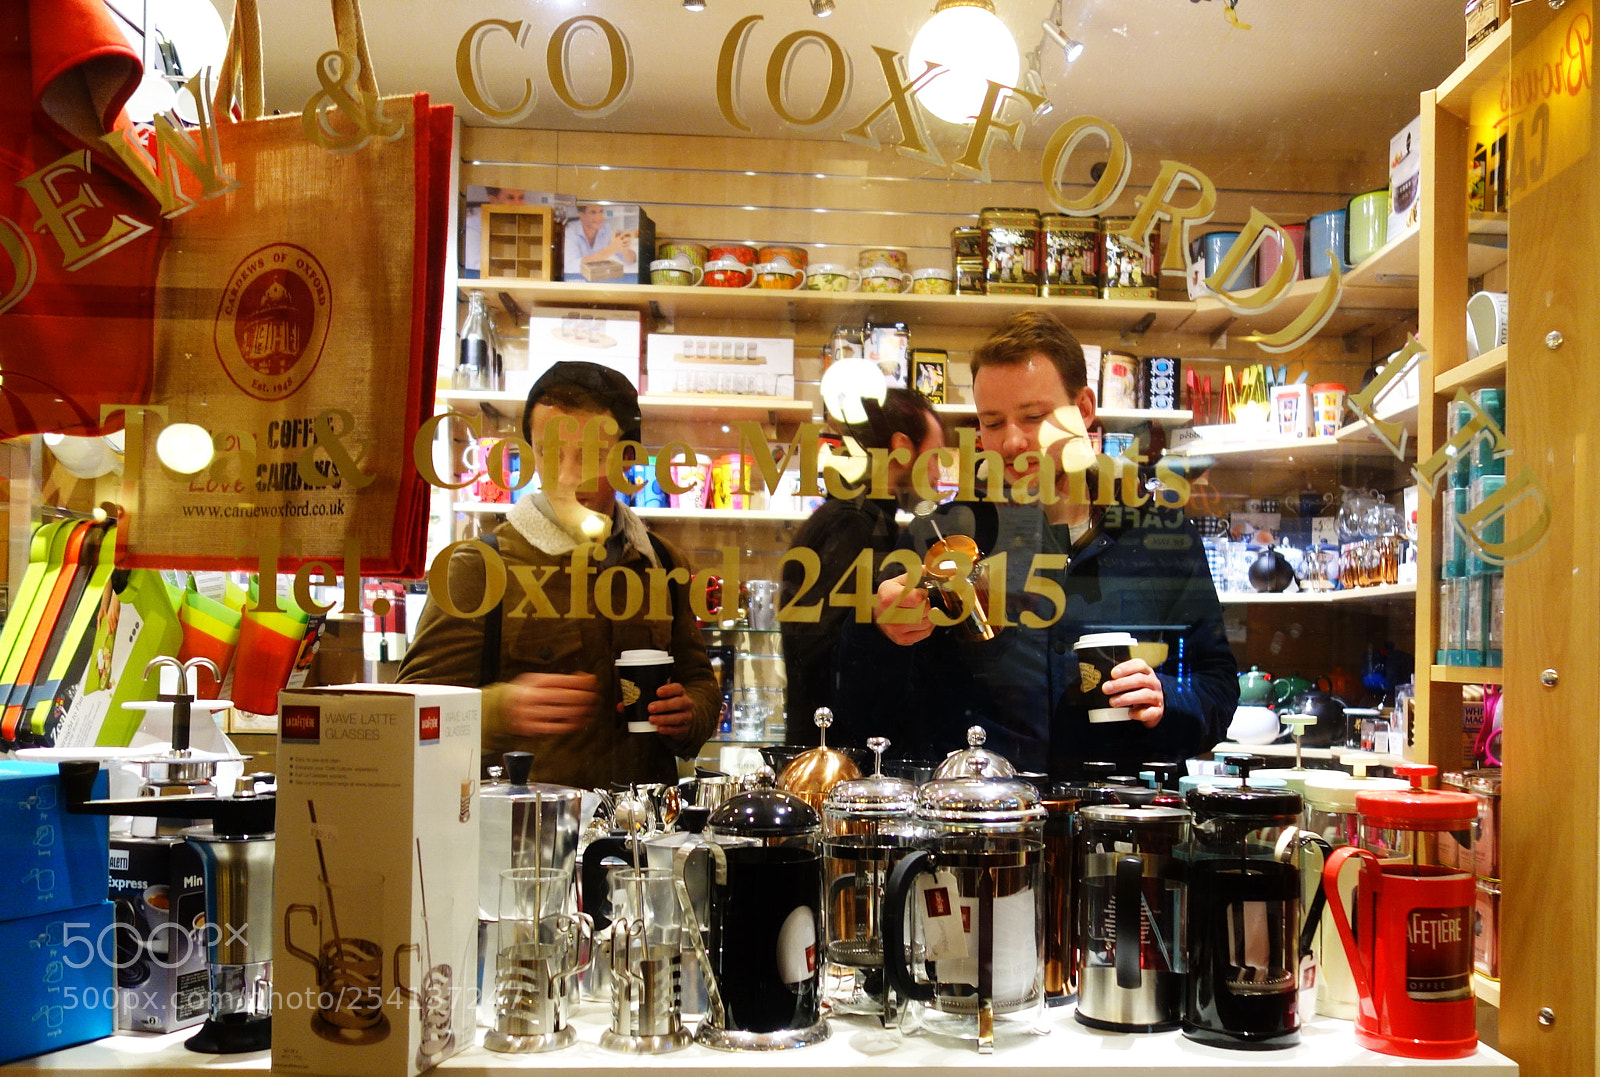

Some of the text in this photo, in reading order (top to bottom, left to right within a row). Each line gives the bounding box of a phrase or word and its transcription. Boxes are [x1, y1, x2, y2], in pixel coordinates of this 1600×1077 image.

[225, 253, 326, 316] CARDEWS OF OXFORD
[301, 50, 404, 154] &
[455, 14, 634, 124] CO
[715, 14, 1343, 353] (OXFORD)
[1347, 331, 1552, 566] LTD
[251, 376, 293, 392] Est. 1948
[268, 416, 336, 449] COFF
[100, 404, 259, 486] Ta
[298, 408, 379, 489] &
[413, 412, 697, 495] Coffee
[730, 420, 1192, 508] Merchants
[255, 460, 342, 493] CARDWS
[182, 500, 345, 519] www.cardewoxford.co.uk
[235, 538, 1068, 629] Tel. Oxford 242315
[325, 713, 398, 725] WAVE LATTE
[445, 709, 478, 723] WAVE LATTE
[325, 728, 380, 741] GLASSES
[445, 725, 471, 738] GLASSES
[108, 876, 149, 891] Express
